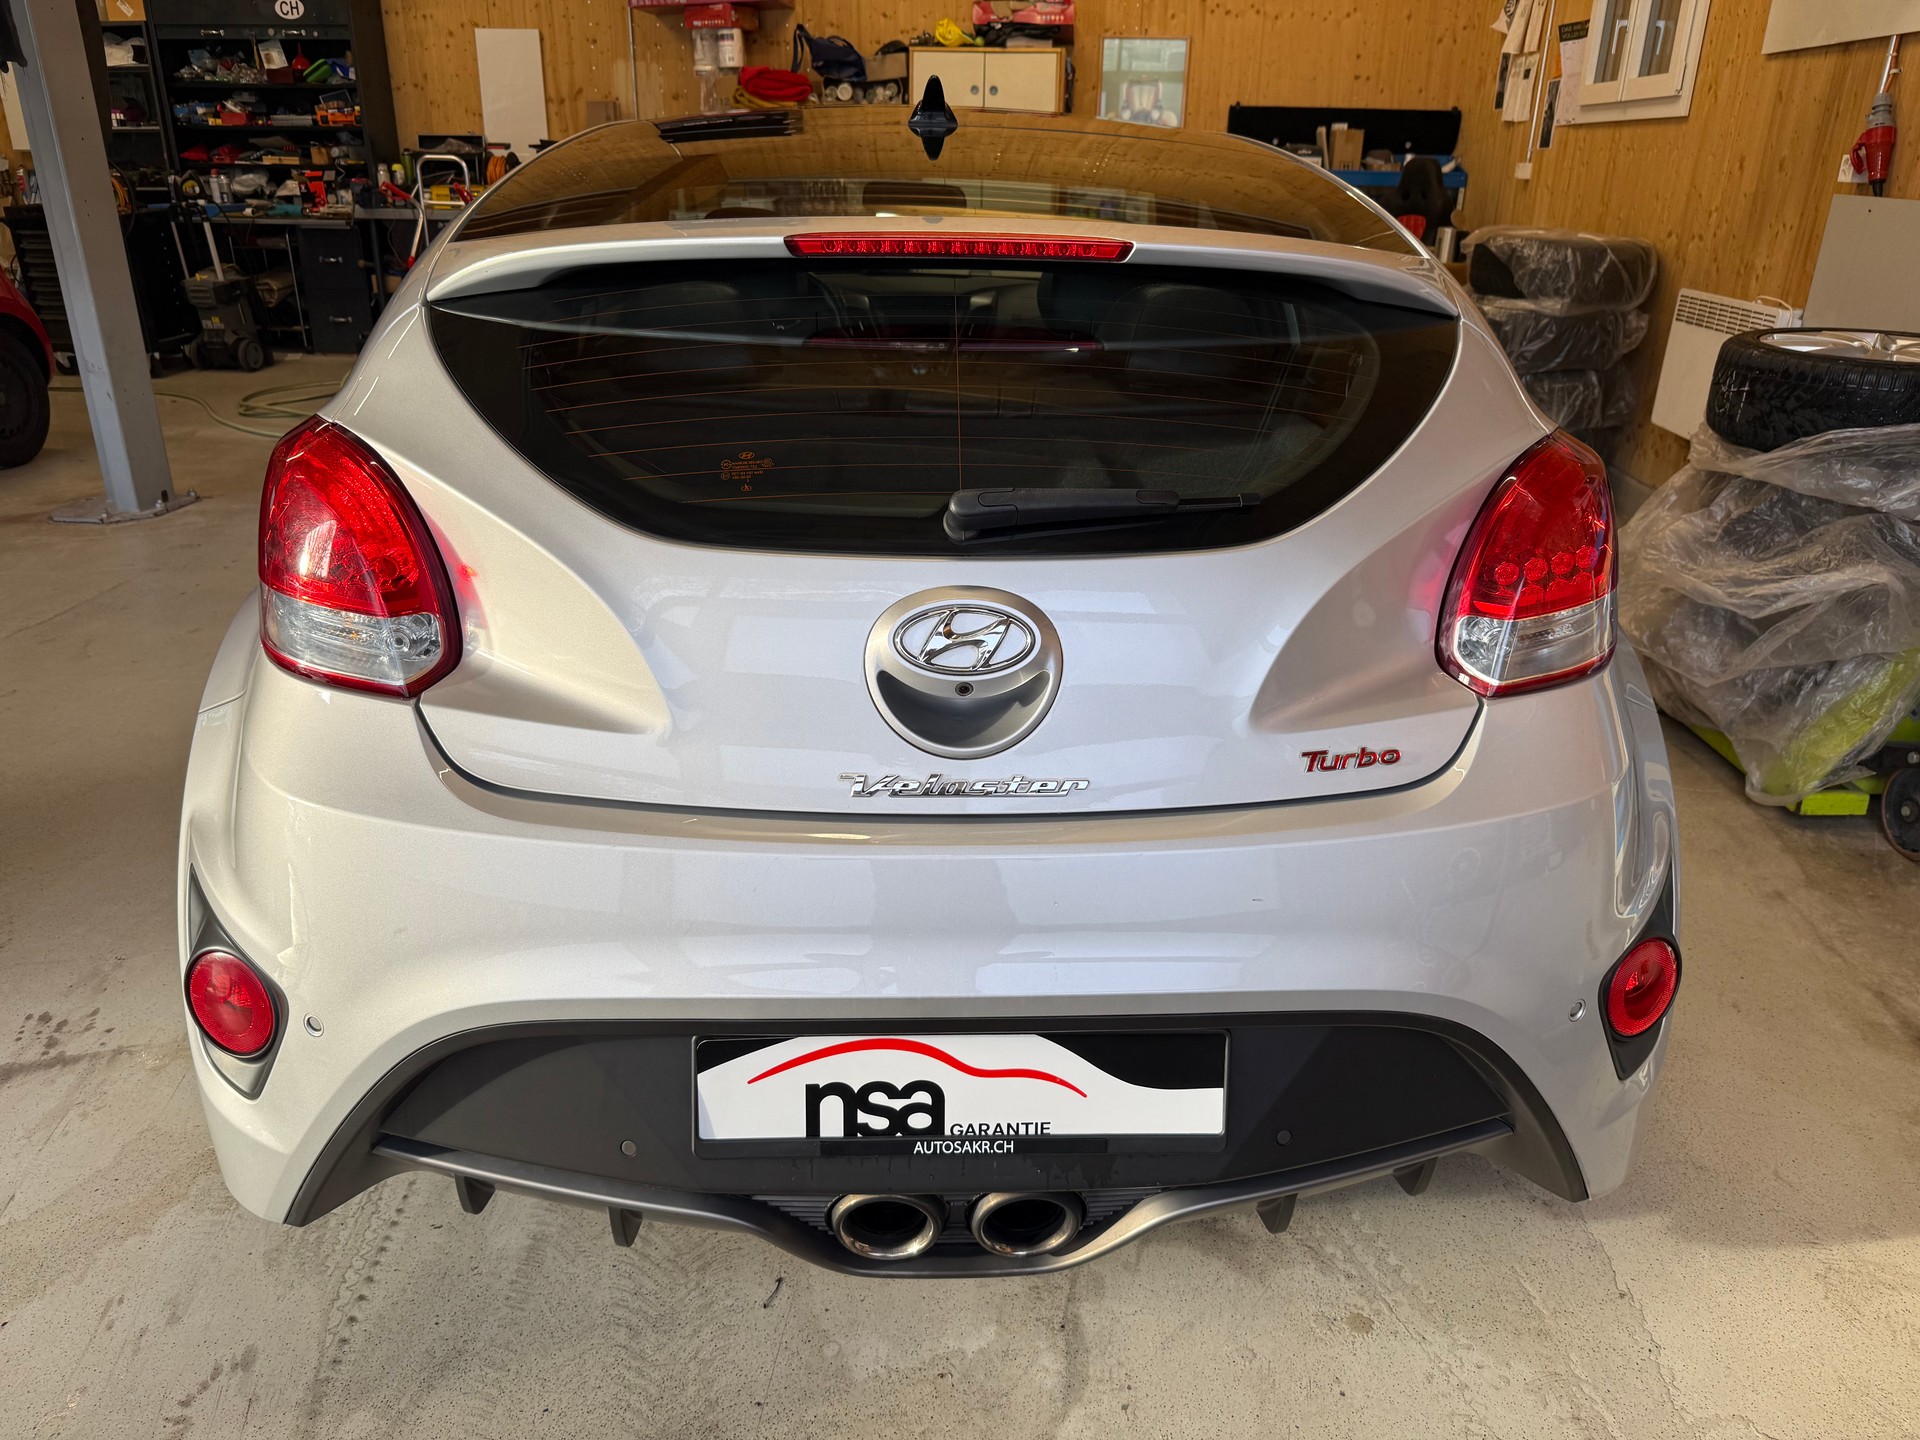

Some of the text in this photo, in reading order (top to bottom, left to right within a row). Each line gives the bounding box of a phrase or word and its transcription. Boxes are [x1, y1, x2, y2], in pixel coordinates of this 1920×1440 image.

[279, 1, 300, 16] CH
[1300, 746, 1402, 773] Turbo
[838, 772, 1090, 798] Veloster
[805, 1080, 946, 1137] nsa
[949, 1121, 1051, 1136] GARANTIE
[913, 1140, 1015, 1154] AUTOSAKR.CH
